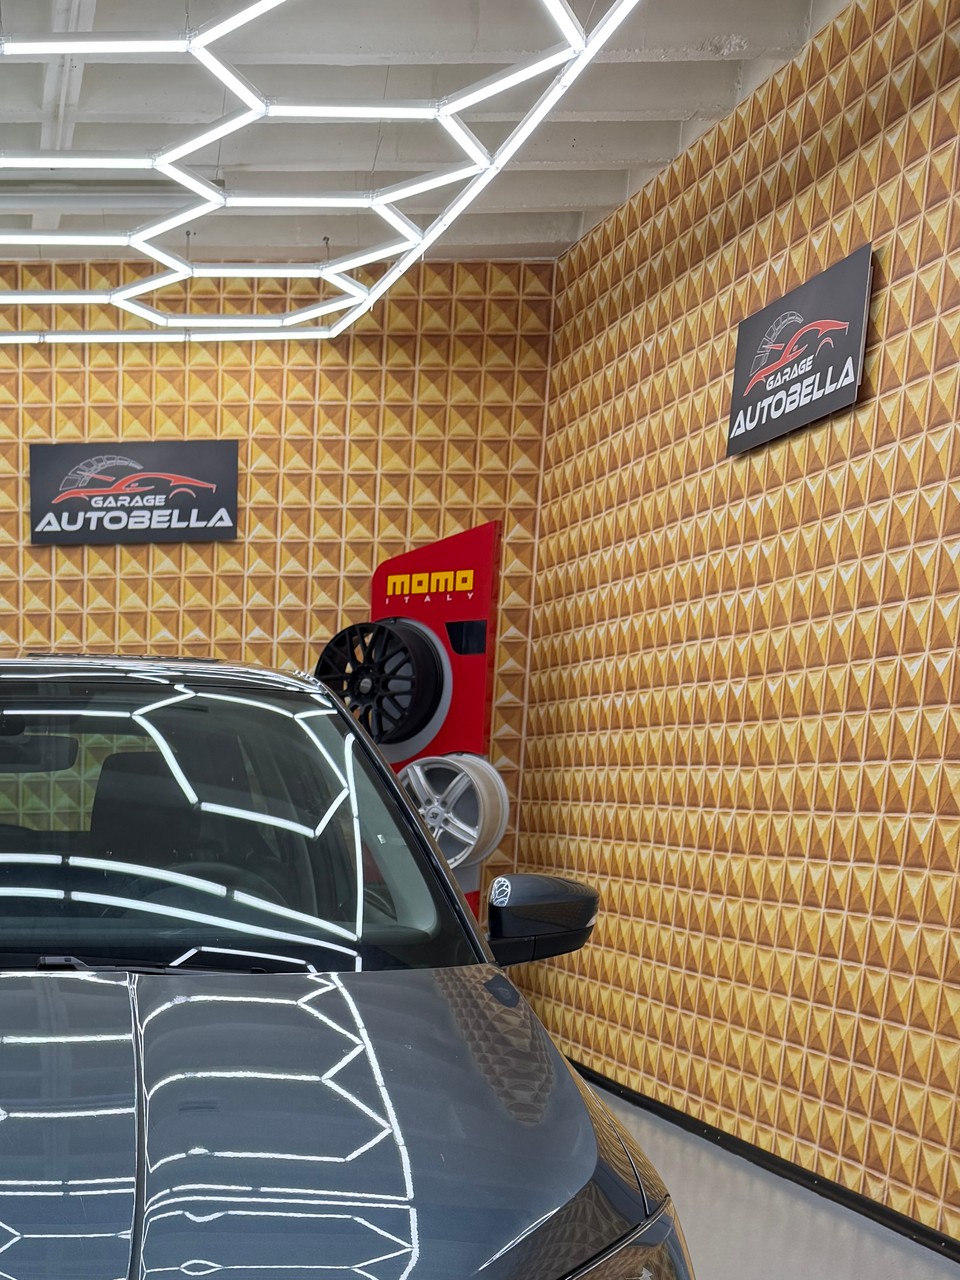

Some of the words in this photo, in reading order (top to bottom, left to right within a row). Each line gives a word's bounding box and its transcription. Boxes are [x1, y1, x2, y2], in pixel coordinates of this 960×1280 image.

[765, 354, 815, 391] GARAGE
[729, 356, 855, 439] AUTOBELLA
[90, 494, 167, 508] GARAGE
[34, 507, 234, 532] AUTOBELLA
[385, 592, 474, 605] ITALY
